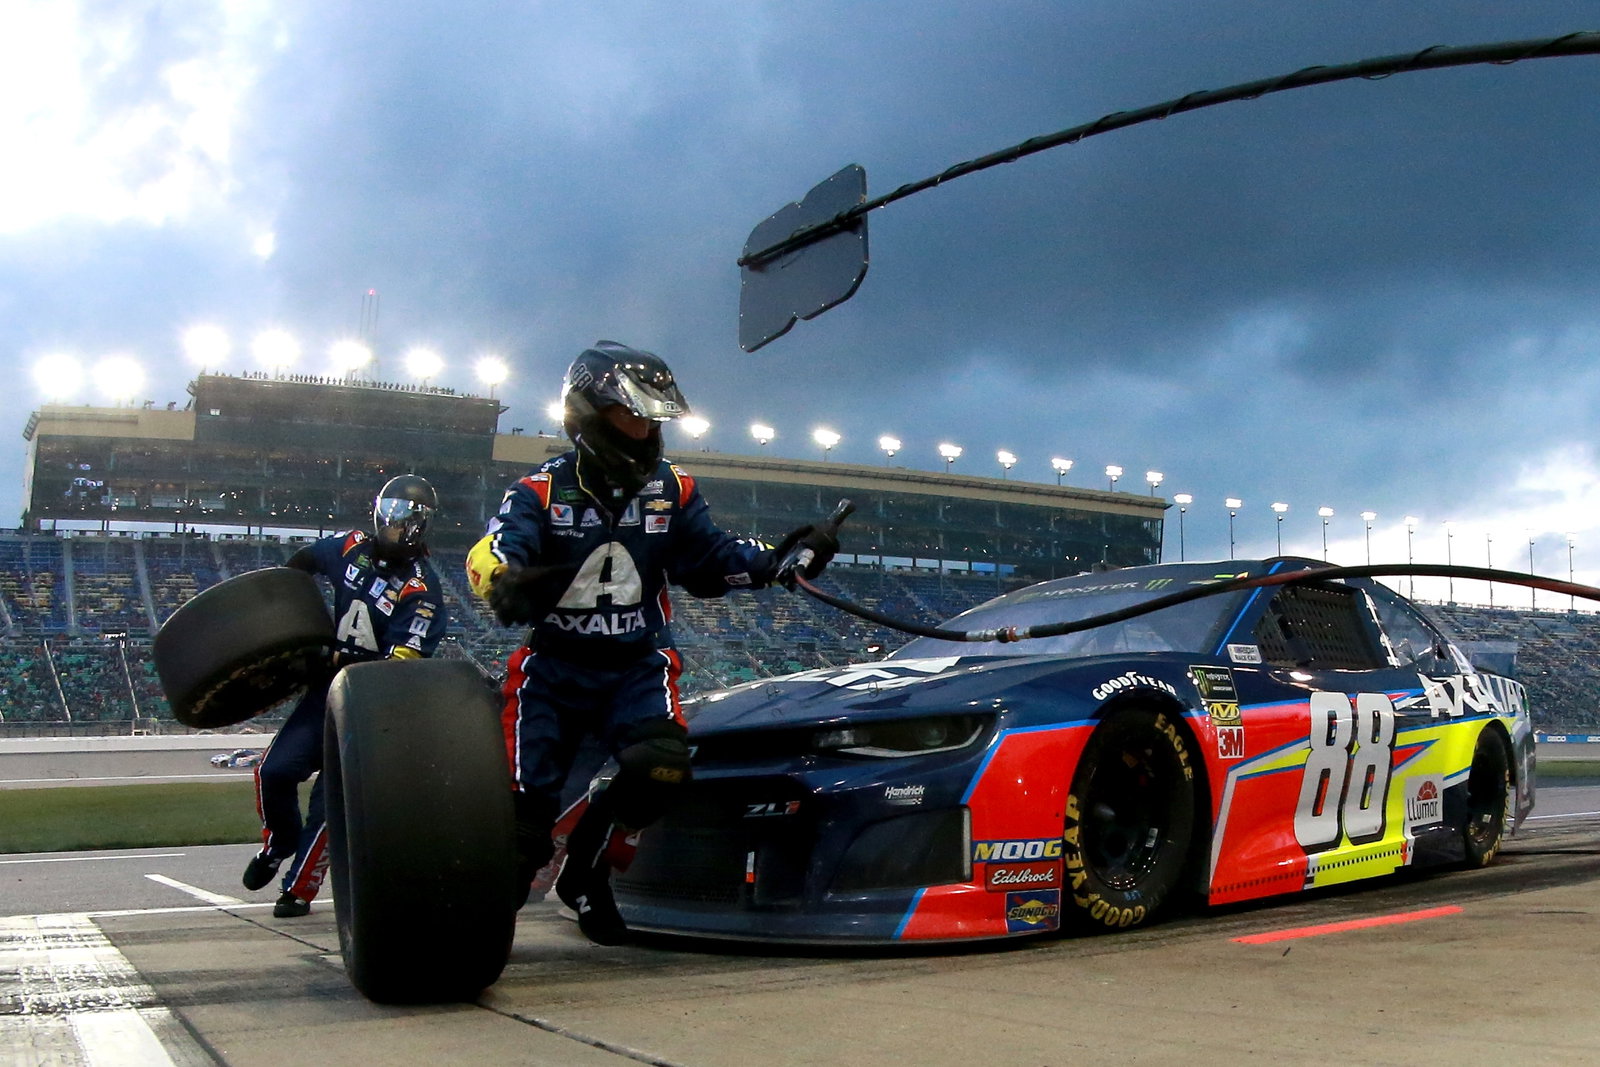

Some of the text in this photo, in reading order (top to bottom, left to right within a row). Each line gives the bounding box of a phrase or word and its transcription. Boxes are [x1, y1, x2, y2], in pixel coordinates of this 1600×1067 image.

[544, 609, 647, 636] AXALTA
[1092, 670, 1177, 701] GOODYEAR
[1154, 711, 1194, 781] EAGLE
[1219, 727, 1243, 757] 3M
[1293, 690, 1396, 848] 88
[884, 785, 926, 798] Hendrick
[743, 800, 801, 818] ZL1
[974, 840, 1062, 861] MOOG
[1064, 793, 1147, 928] GOODYEAR
[991, 867, 1055, 885] Edelbrock
[1008, 904, 1058, 920] SUNOCO
